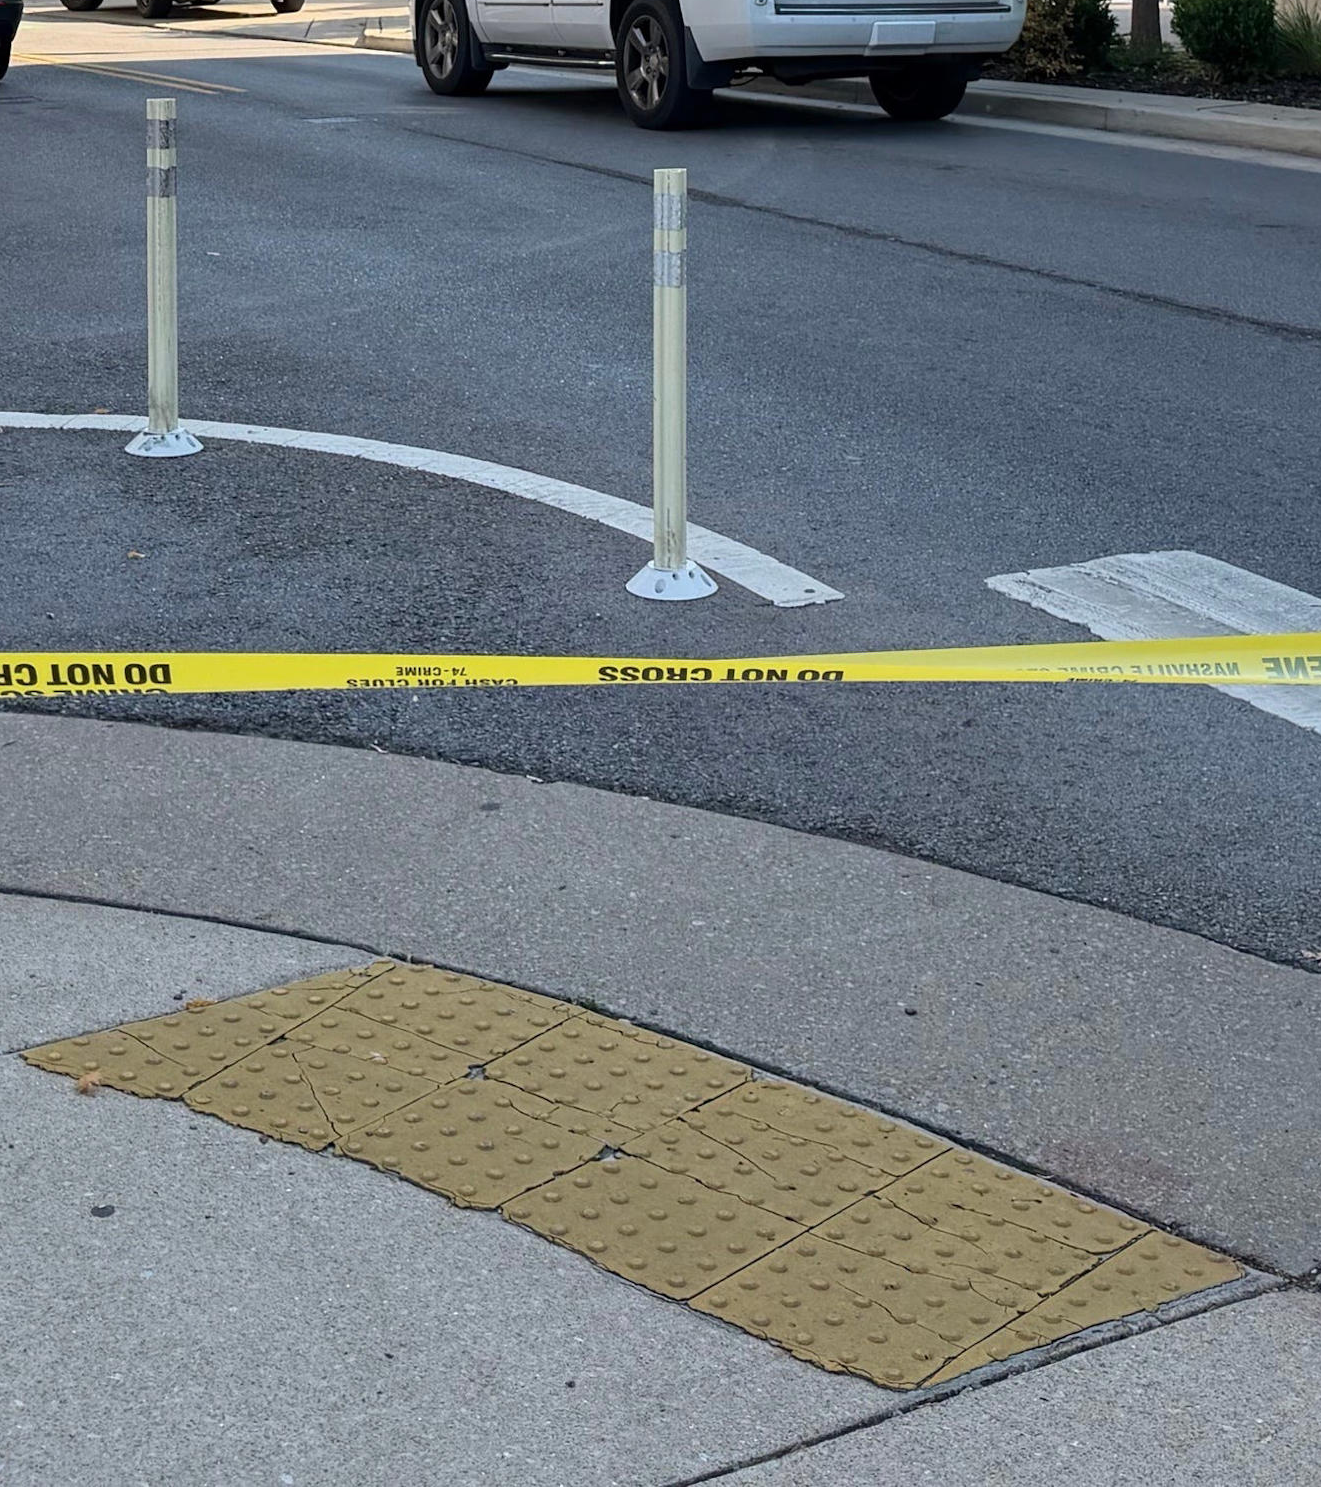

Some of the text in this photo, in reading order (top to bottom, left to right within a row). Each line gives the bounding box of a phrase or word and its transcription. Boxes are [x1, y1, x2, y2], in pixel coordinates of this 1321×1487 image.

[46, 663, 117, 686] NOT
[124, 664, 172, 685] DO
[395, 666, 468, 676] 74-CRIME
[598, 665, 844, 682] DO NOT CROSS
